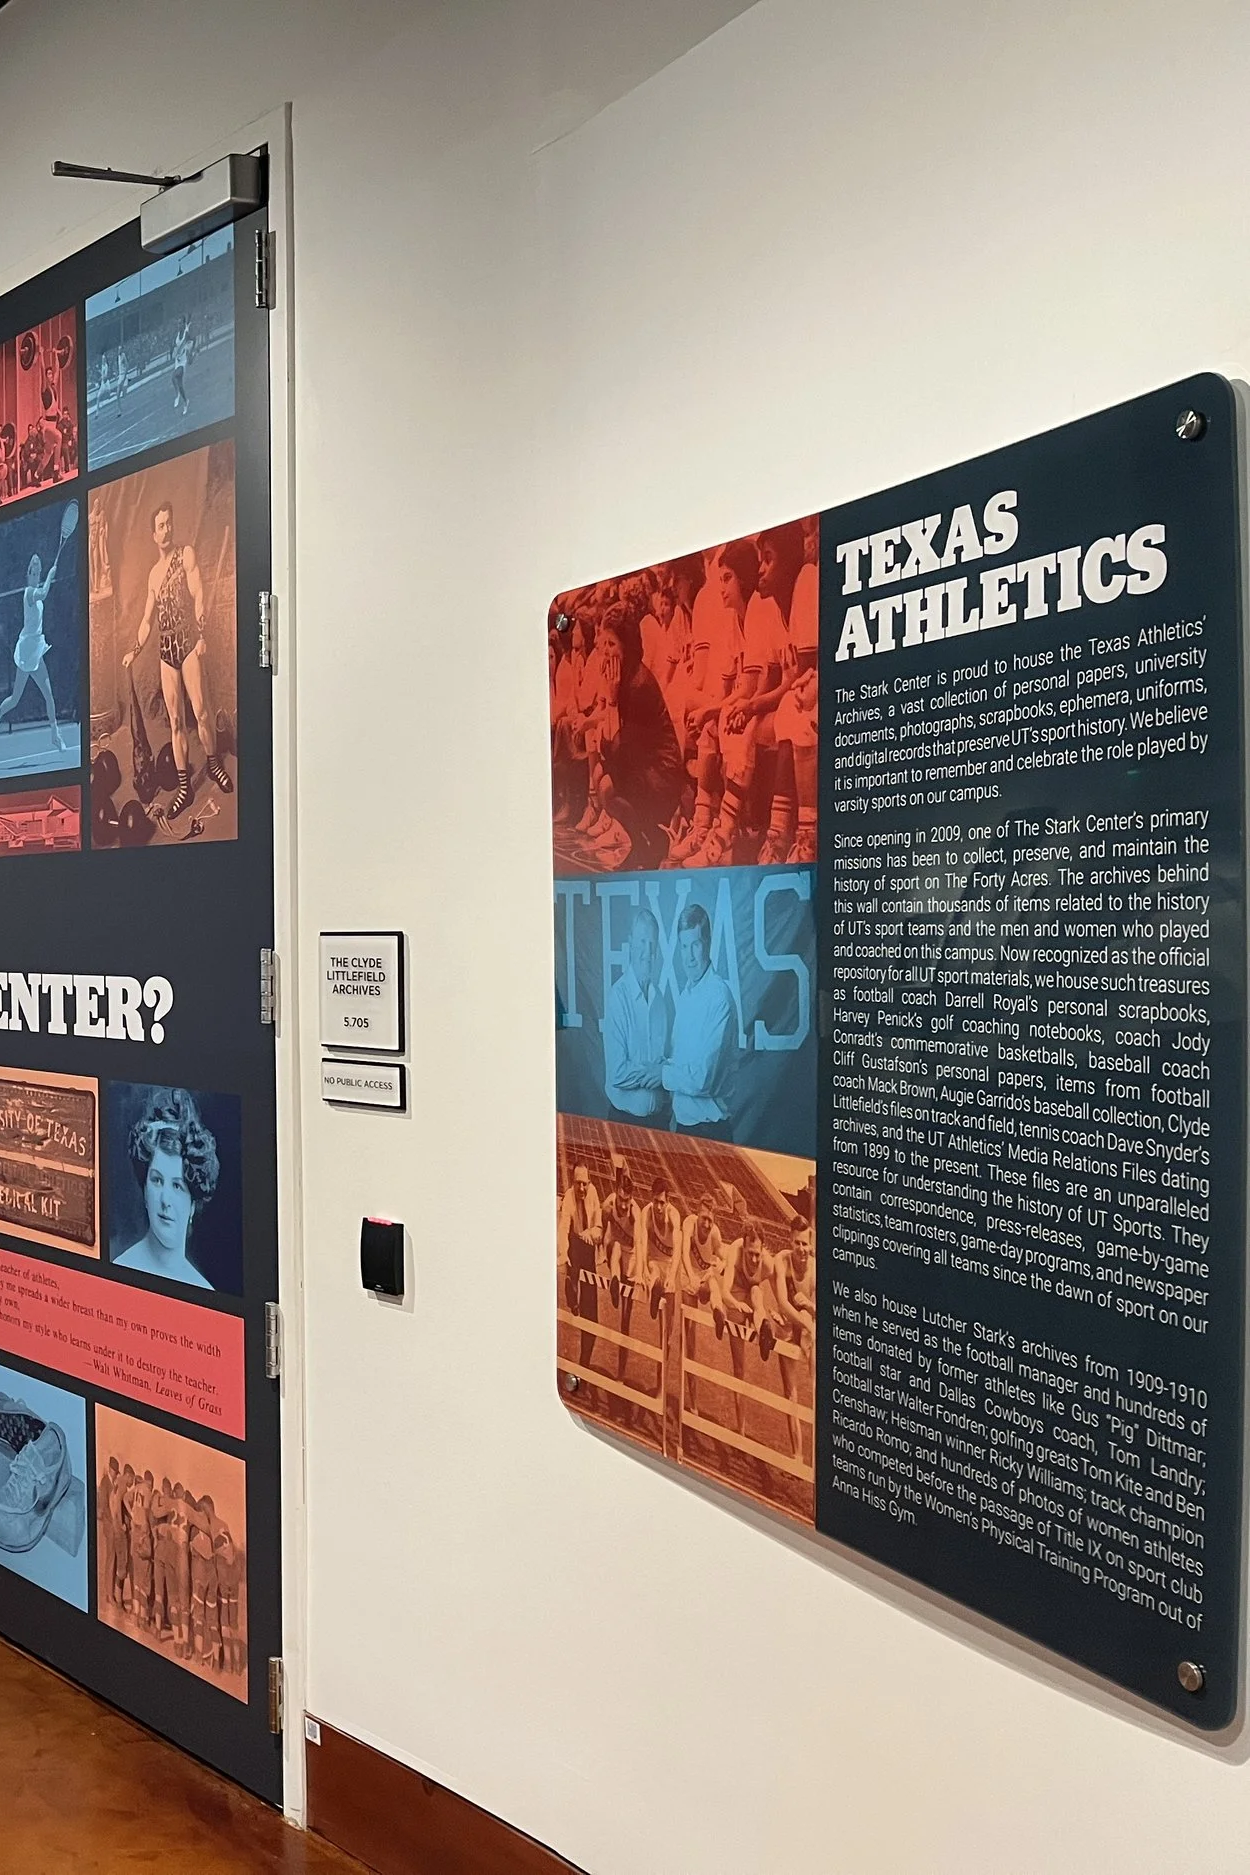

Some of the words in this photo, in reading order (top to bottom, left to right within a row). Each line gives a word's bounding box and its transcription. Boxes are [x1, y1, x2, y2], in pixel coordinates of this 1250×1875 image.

[836, 490, 1019, 596] TEXAS
[835, 524, 1168, 662] ATHLETICS
[834, 687, 856, 704] The
[859, 679, 889, 700] Stark
[893, 674, 932, 694] Center
[937, 669, 947, 685] is
[952, 659, 988, 687] proud
[994, 659, 1008, 675] to
[1013, 651, 1054, 671] house
[1059, 643, 1082, 662] the
[1088, 635, 1131, 656] Texas
[1137, 614, 1206, 647] Athletics'
[834, 707, 883, 726] Archives,
[888, 704, 895, 717] a
[900, 697, 925, 714] vast
[930, 687, 988, 710] collection
[993, 679, 1007, 699] of
[1013, 668, 1070, 700] personal
[1076, 663, 1128, 689] papers,
[1135, 646, 1207, 675] university
[834, 726, 897, 748] documents,
[899, 712, 976, 742] photographs,
[978, 699, 1057, 726] scrapbooks,
[1059, 689, 1133, 717] ephemera,
[1136, 677, 1208, 702] uniforms,
[833, 833, 863, 849] Since
[866, 829, 911, 850] opening
[915, 827, 926, 843] in
[930, 824, 963, 843] 2009,
[968, 826, 992, 840] one
[996, 819, 1010, 838] of
[1014, 819, 1040, 837] The
[1044, 815, 1080, 835] Stark
[1086, 810, 1144, 832] Center's
[1150, 808, 1209, 833] primary
[326, 970, 386, 983] LITTLEFIELD
[330, 957, 349, 968] THE
[351, 957, 382, 969] CLYDE
[553, 871, 811, 1051] TEXAS
[332, 984, 381, 996] ARCHIVES
[833, 988, 846, 1001] as
[852, 985, 894, 1003] football
[901, 989, 937, 1006] coach
[945, 991, 984, 1009] Darrell
[993, 993, 1038, 1016] Royal's
[1047, 998, 1108, 1018] personal
[1118, 1001, 1210, 1026] scrapbooks,
[343, 1016, 369, 1028] 5.705
[324, 1076, 335, 1085] NO
[336, 1077, 363, 1088] PUBLIC
[364, 1079, 393, 1091] ACCESS
[26, 1112, 41, 1132] OF
[46, 1118, 87, 1156] TEXAS
[832, 1116, 879, 1138] archives,
[882, 1124, 903, 1141] and
[905, 1126, 925, 1144] the
[928, 1130, 945, 1147] UT
[947, 1133, 1005, 1157] Athletics'
[1008, 1142, 1048, 1165] Media
[1052, 1149, 1118, 1178] Relations
[1122, 1161, 1157, 1185] Files
[1161, 1168, 1210, 1198] dating
[41, 1196, 62, 1218] KIT
[832, 1182, 872, 1202] contain
[880, 1192, 977, 1227] correspondence,
[986, 1215, 1085, 1253] press-releases,
[1096, 1240, 1210, 1278] game-by-game
[22, 1269, 29, 1279] of
[5, 1282, 16, 1292] me
[17, 1285, 42, 1300] spreads
[43, 1294, 49, 1304] a
[50, 1296, 70, 1309] wider
[72, 1300, 94, 1317] breast
[96, 1308, 113, 1323] than
[115, 1317, 127, 1328] my
[130, 1322, 147, 1334] own
[150, 1328, 177, 1344] proves
[180, 1335, 193, 1349] the
[196, 1342, 221, 1357] width
[832, 1279, 850, 1299] We
[854, 1287, 877, 1307] also
[882, 1294, 917, 1319] house
[922, 1306, 968, 1334] Lutcher
[973, 1321, 1015, 1349] Stark's
[1021, 1339, 1078, 1369] archives
[1085, 1354, 1119, 1382] from
[1127, 1368, 1208, 1409] 1909-1910
[22, 1320, 32, 1332] my
[35, 1324, 50, 1336] style
[52, 1329, 67, 1342] who
[69, 1333, 91, 1351] learns
[93, 1345, 115, 1359] under
[117, 1352, 122, 1362] it
[125, 1354, 134, 1366] to
[136, 1357, 166, 1378] destroy
[169, 1368, 182, 1382] the
[155, 1381, 182, 1401] Leaves
[185, 1394, 196, 1408] of
[197, 1397, 222, 1416] Grass
[832, 1475, 859, 1499] Anna
[862, 1487, 886, 1511] Hiss
[888, 1500, 917, 1525] Gym.
